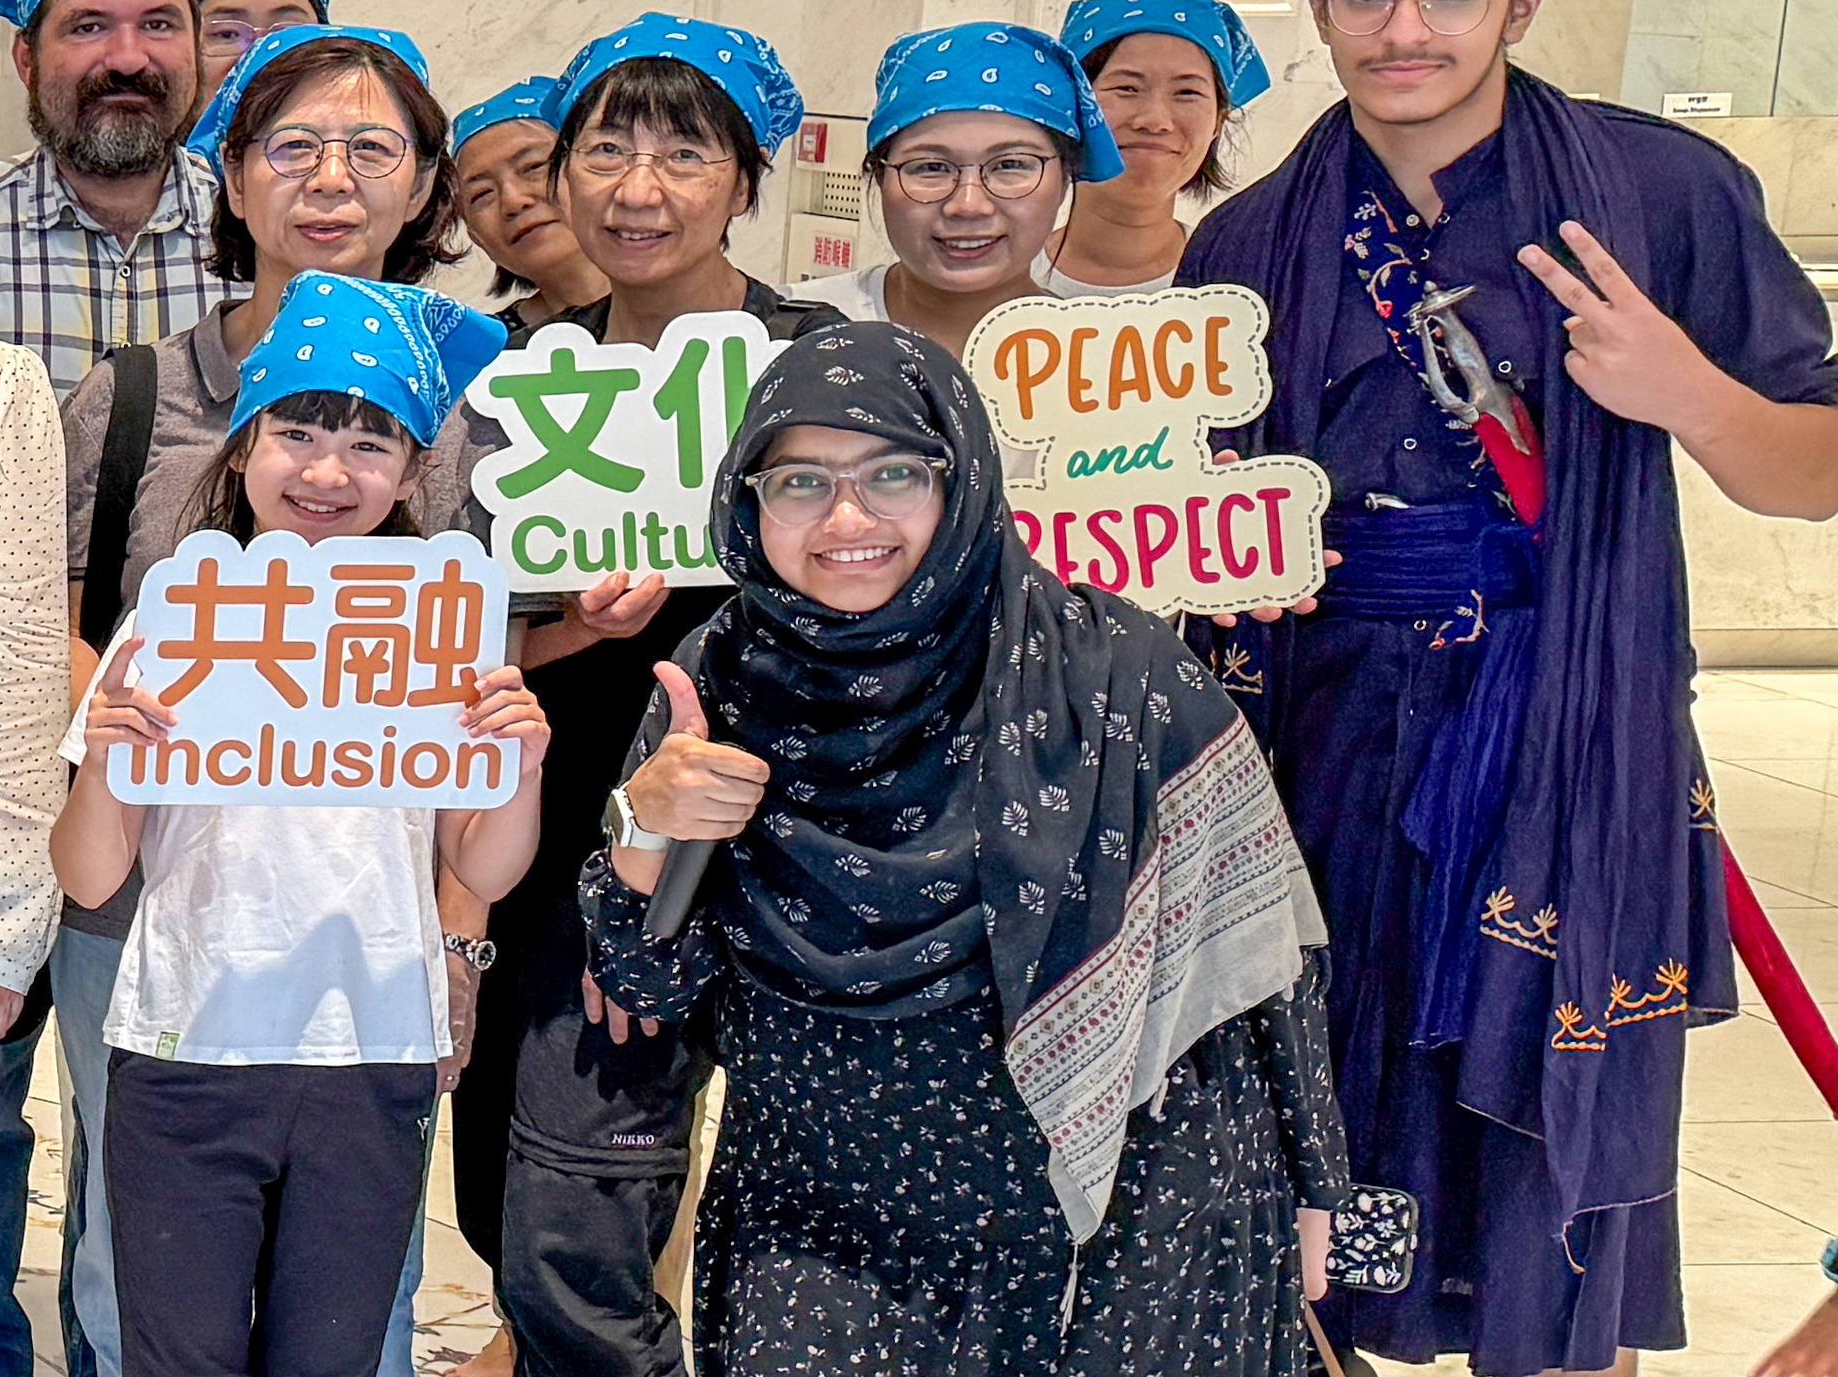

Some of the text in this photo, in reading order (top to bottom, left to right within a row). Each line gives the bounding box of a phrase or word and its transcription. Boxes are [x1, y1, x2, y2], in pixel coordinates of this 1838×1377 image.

[993, 316, 1233, 421] PEACE
[1066, 425, 1174, 478] and
[511, 511, 718, 574] Cultu
[157, 557, 484, 709] 共融
[130, 723, 502, 790] Inclusion
